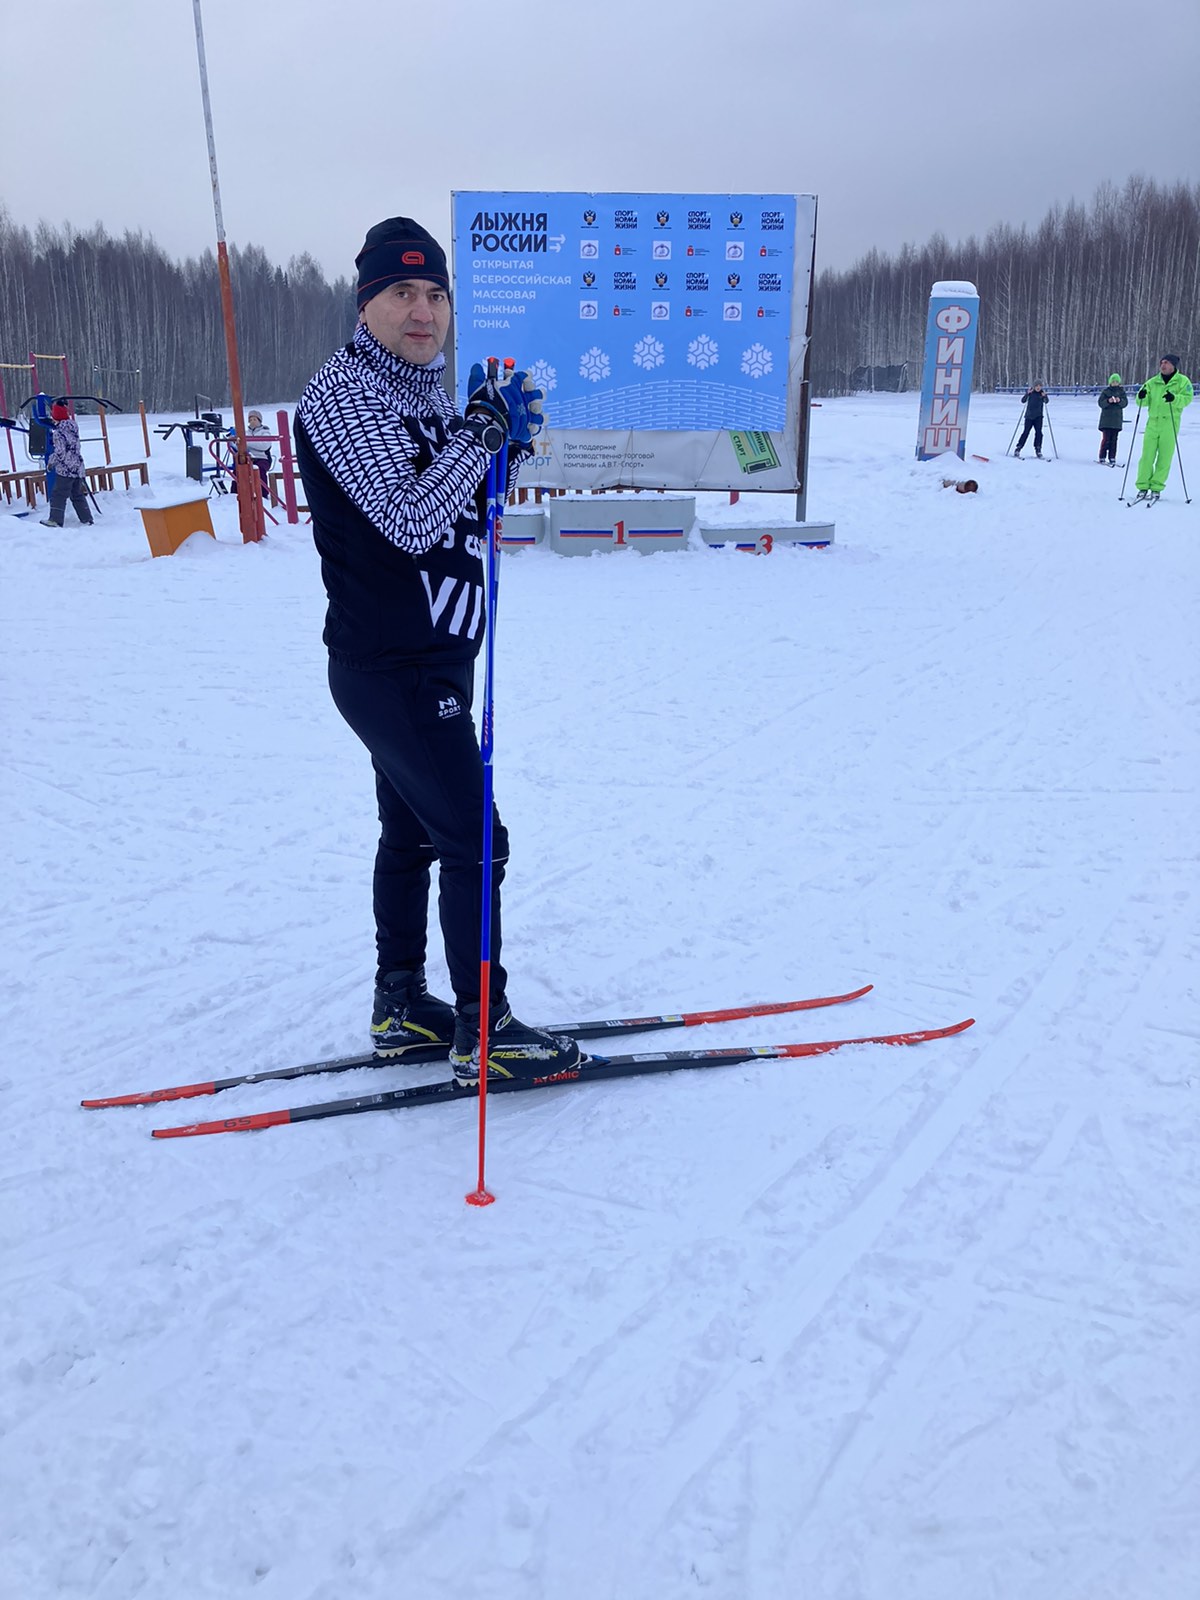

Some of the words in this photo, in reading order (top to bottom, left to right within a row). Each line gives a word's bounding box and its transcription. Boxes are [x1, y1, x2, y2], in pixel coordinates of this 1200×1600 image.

[470, 212, 547, 231] ЛЫЖНЯ
[472, 234, 547, 252] РОССИИ
[473, 260, 534, 269] ОТКРЫТАЯ
[473, 274, 571, 284] ВСЕРОССИЙСКАЯ
[473, 290, 536, 299] МАССОВАЯ
[473, 305, 526, 314] ЛЫЖНАЯ
[473, 320, 510, 328] ГОНКА
[926, 306, 970, 454] ФИНИШ
[564, 443, 577, 451] При
[733, 435, 746, 456] СТАРТ
[754, 431, 766, 453] ИНИШ
[522, 456, 552, 470] орт
[614, 521, 627, 544] 1
[756, 534, 773, 555] 3
[438, 706, 461, 716] SPORT
[533, 1071, 580, 1084] ATOMIC
